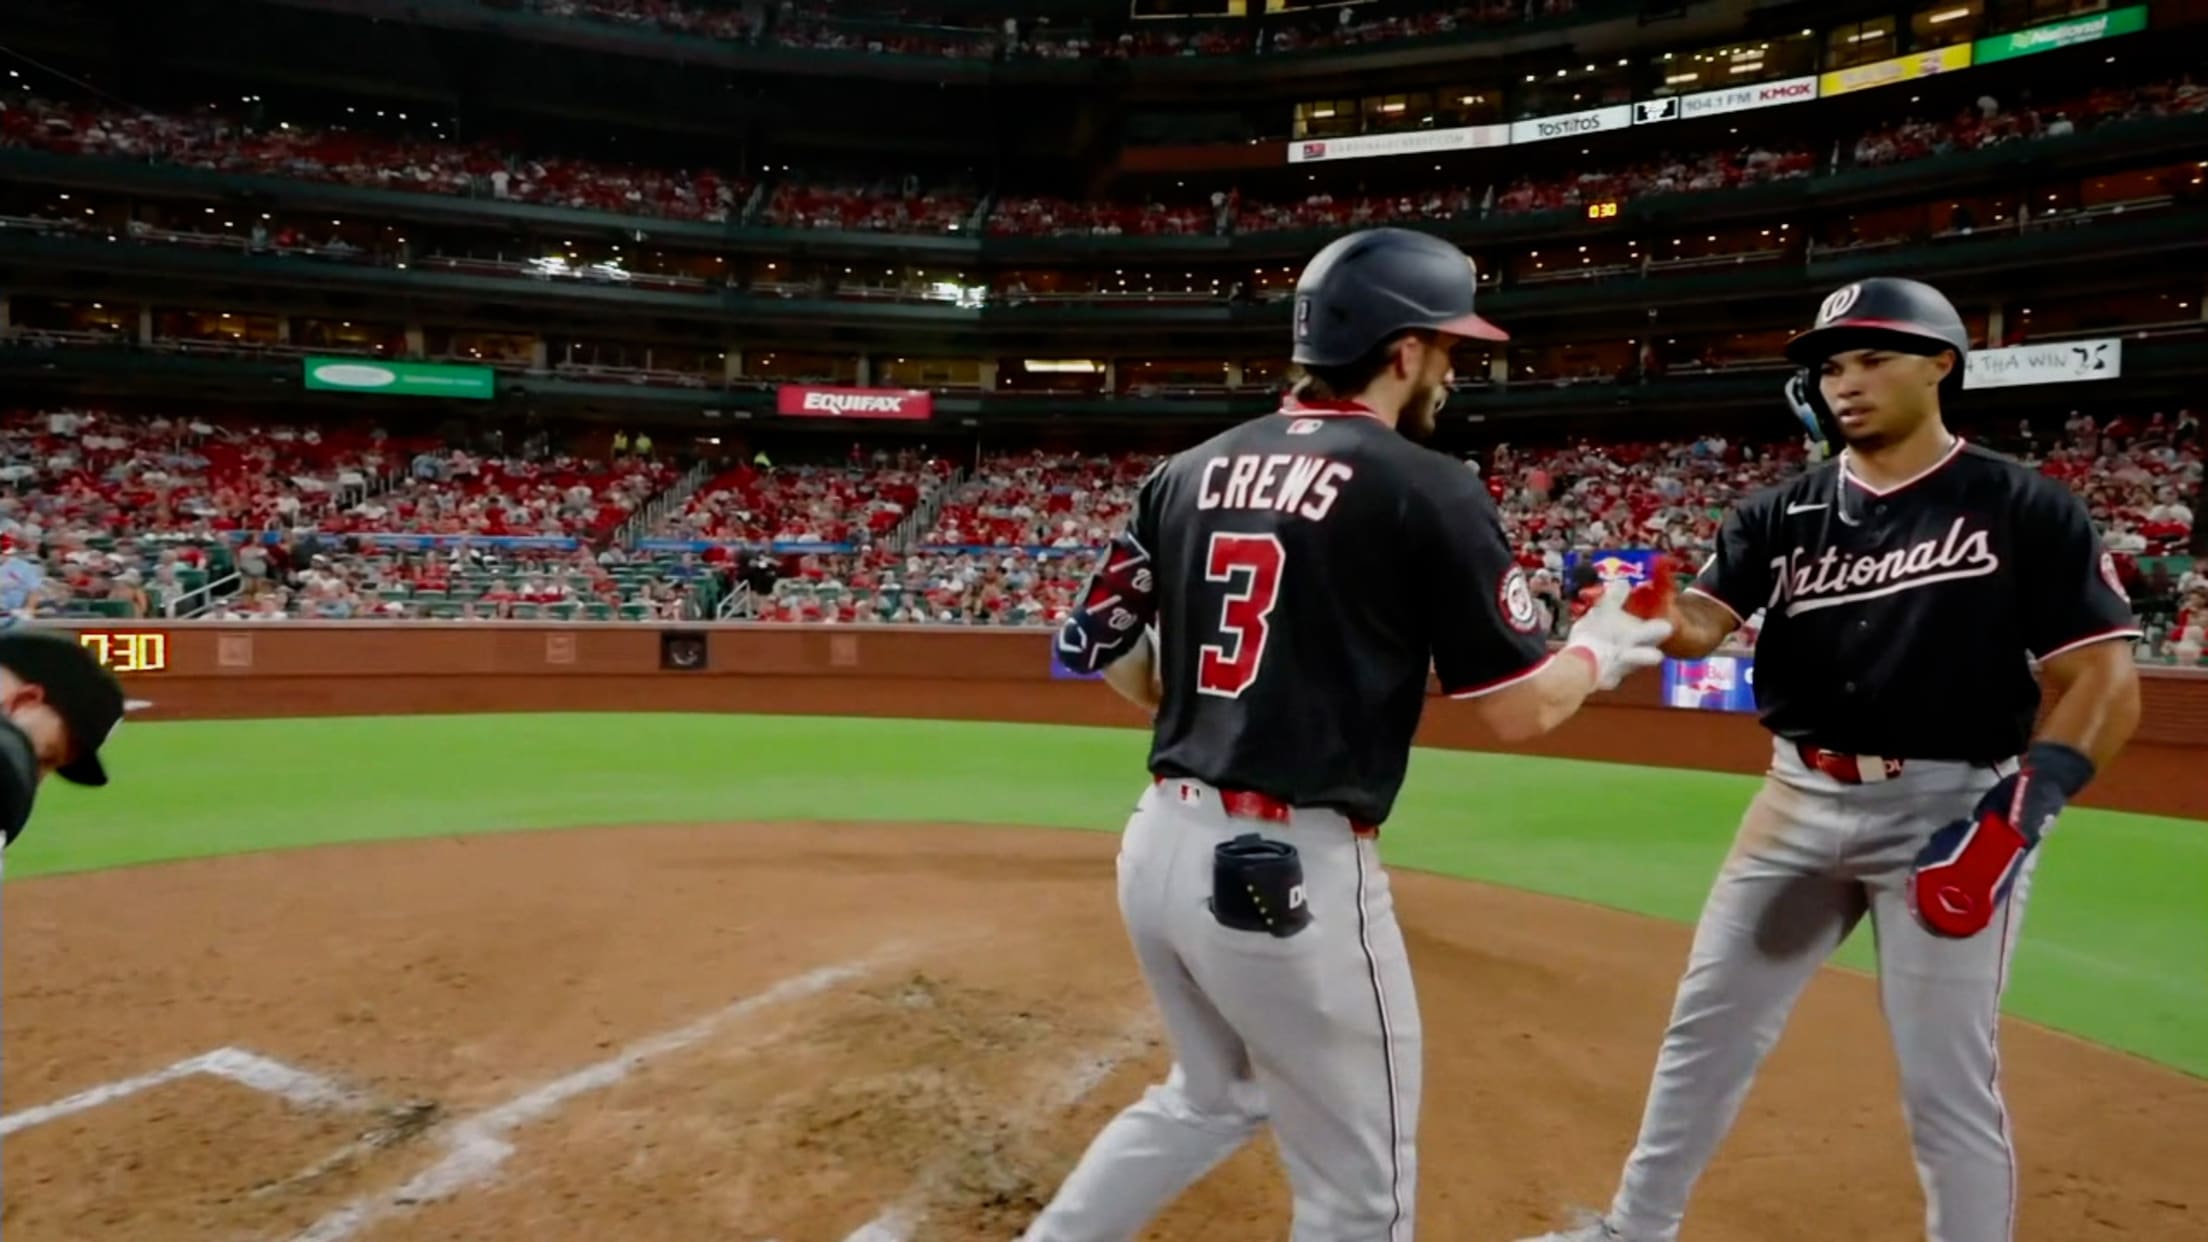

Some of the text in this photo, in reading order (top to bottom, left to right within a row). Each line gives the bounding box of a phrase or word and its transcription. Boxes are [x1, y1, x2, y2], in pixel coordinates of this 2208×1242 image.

[1727, 91, 1752, 106] FM
[1759, 83, 1811, 102] KMOX
[2028, 353, 2068, 369] WIN
[803, 391, 902, 415] EQUIFAX
[1197, 454, 1354, 521] CREWS
[1767, 516, 1999, 612] Nationals
[1197, 531, 1287, 699] 3
